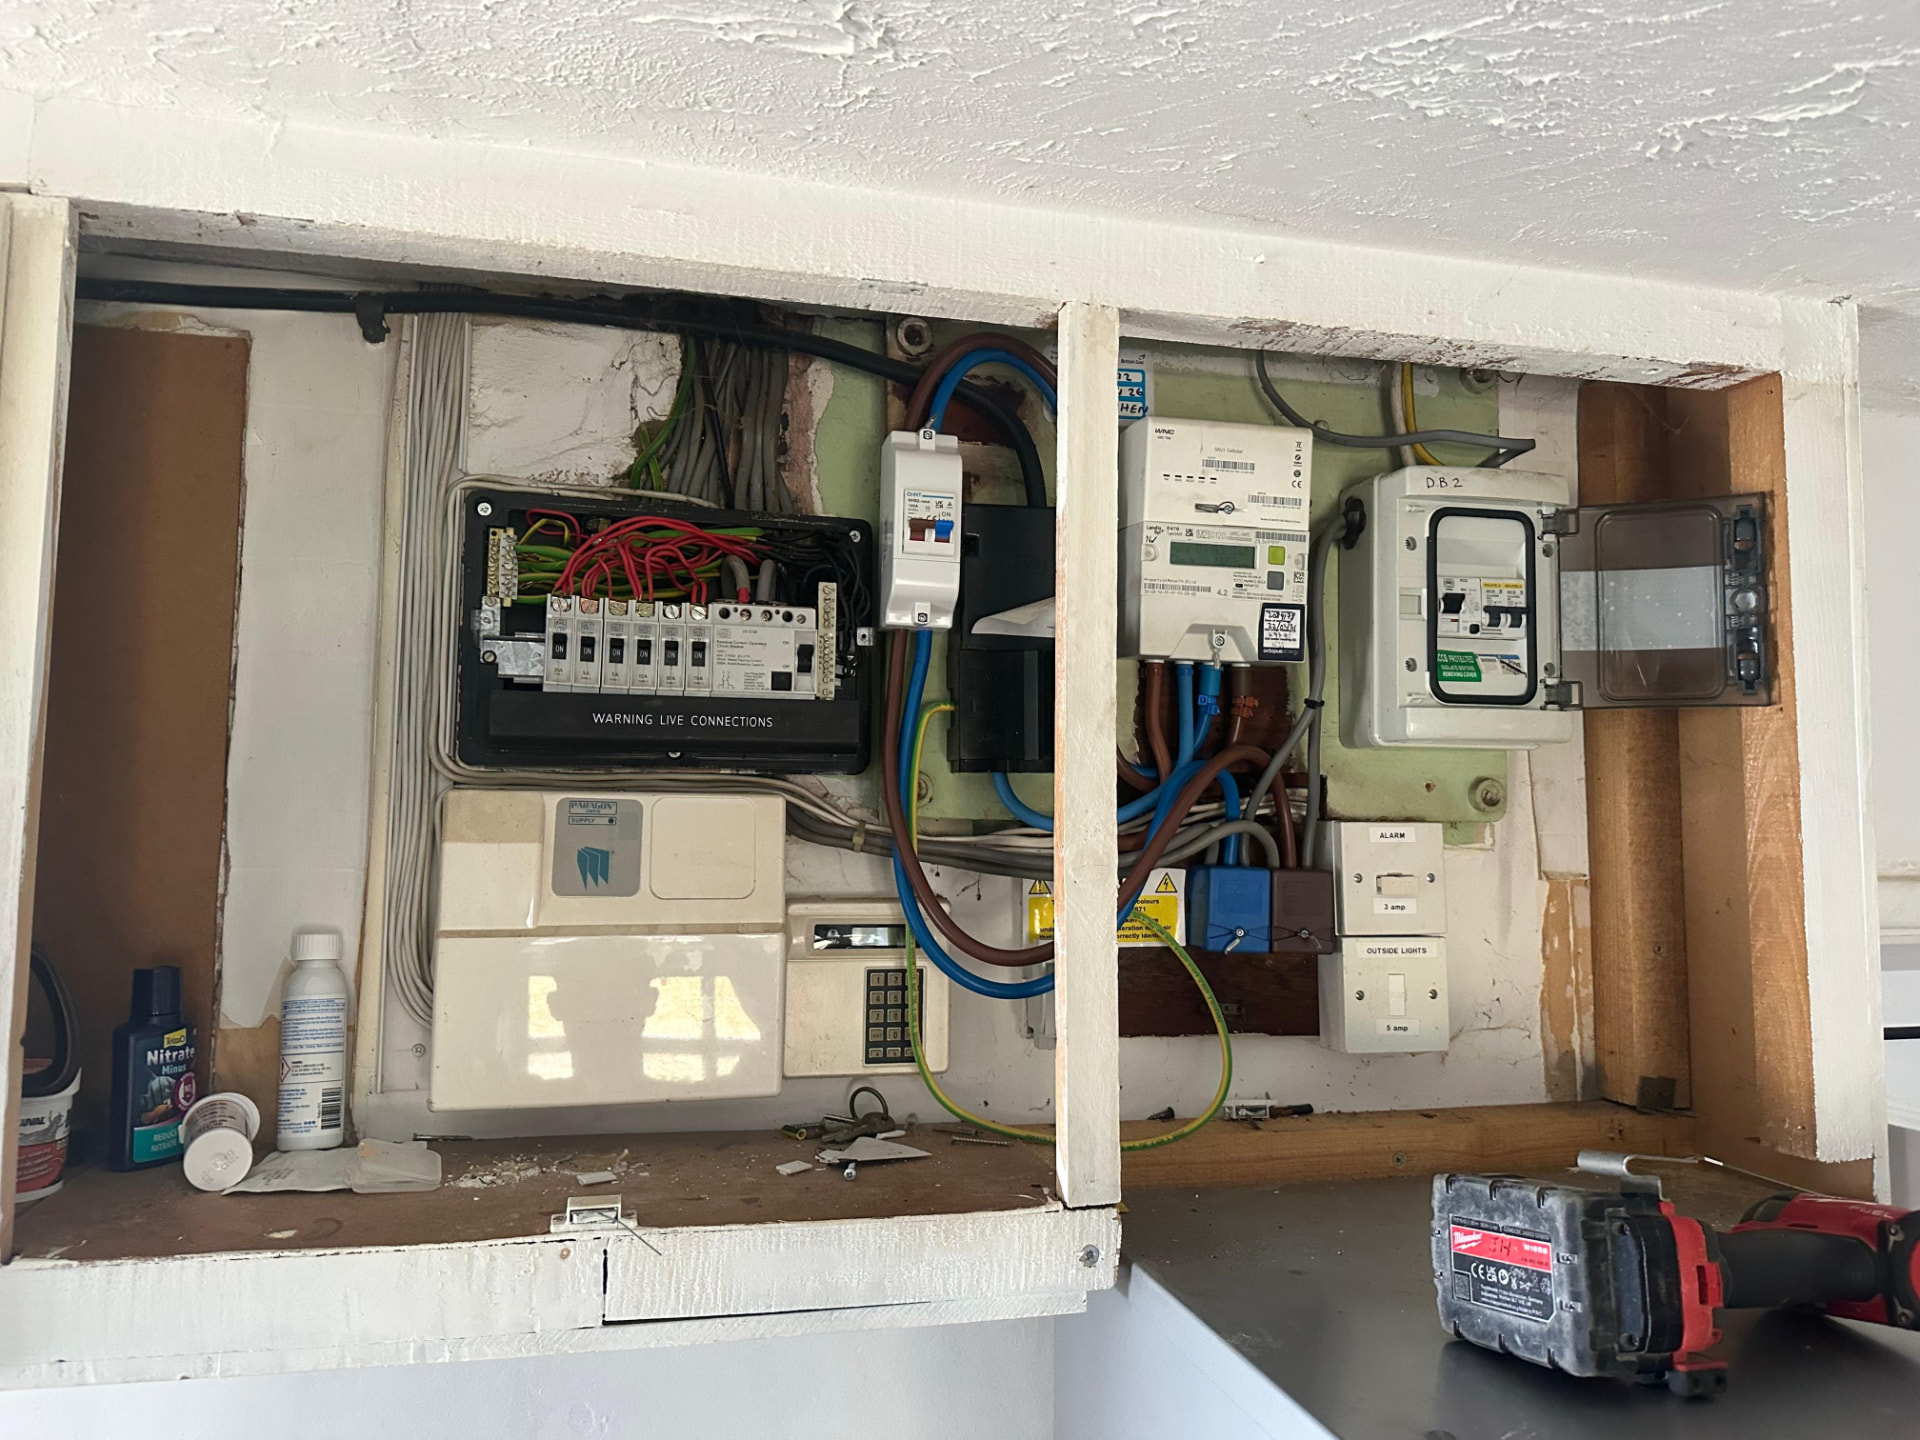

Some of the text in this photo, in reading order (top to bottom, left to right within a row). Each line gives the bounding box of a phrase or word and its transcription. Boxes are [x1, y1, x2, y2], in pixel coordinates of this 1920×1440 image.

[583, 647, 592, 655] ON
[639, 650, 648, 658] ON
[666, 651, 676, 659] ON
[694, 651, 703, 659] ON
[592, 712, 773, 728] WARNING LIVE CONNECTIONS
[1391, 904, 1406, 912] amp
[1386, 1024, 1408, 1033] 5 amp
[146, 1046, 196, 1066] Nitrate
[161, 1063, 187, 1076] Minus
[1848, 1204, 1895, 1219] FUEL
